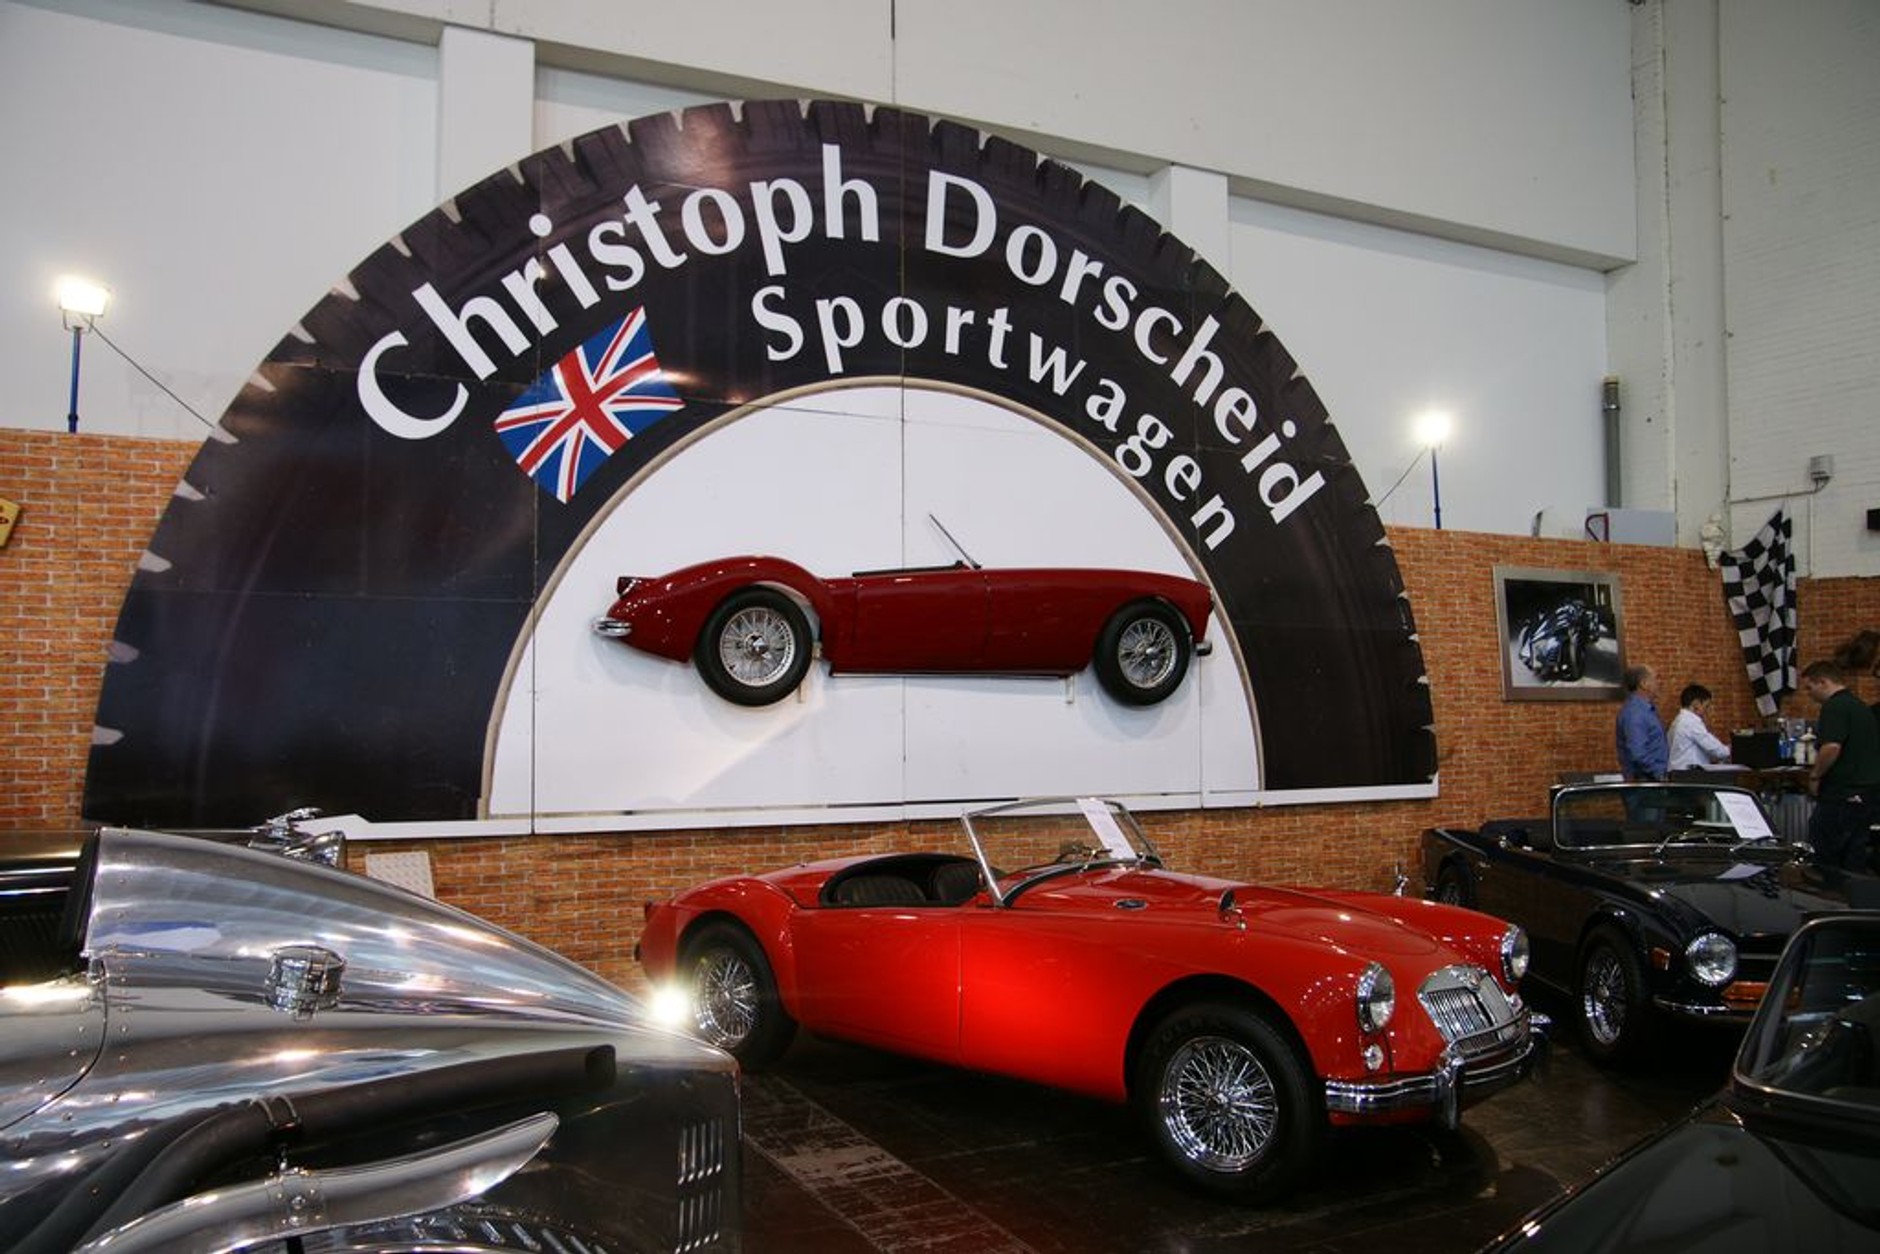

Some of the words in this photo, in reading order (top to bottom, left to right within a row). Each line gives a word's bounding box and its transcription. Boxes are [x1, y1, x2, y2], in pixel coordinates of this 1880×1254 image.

[357, 143, 880, 440] Christoph
[925, 170, 1325, 524] Dorscheid
[751, 285, 1236, 551] Sportwagen
